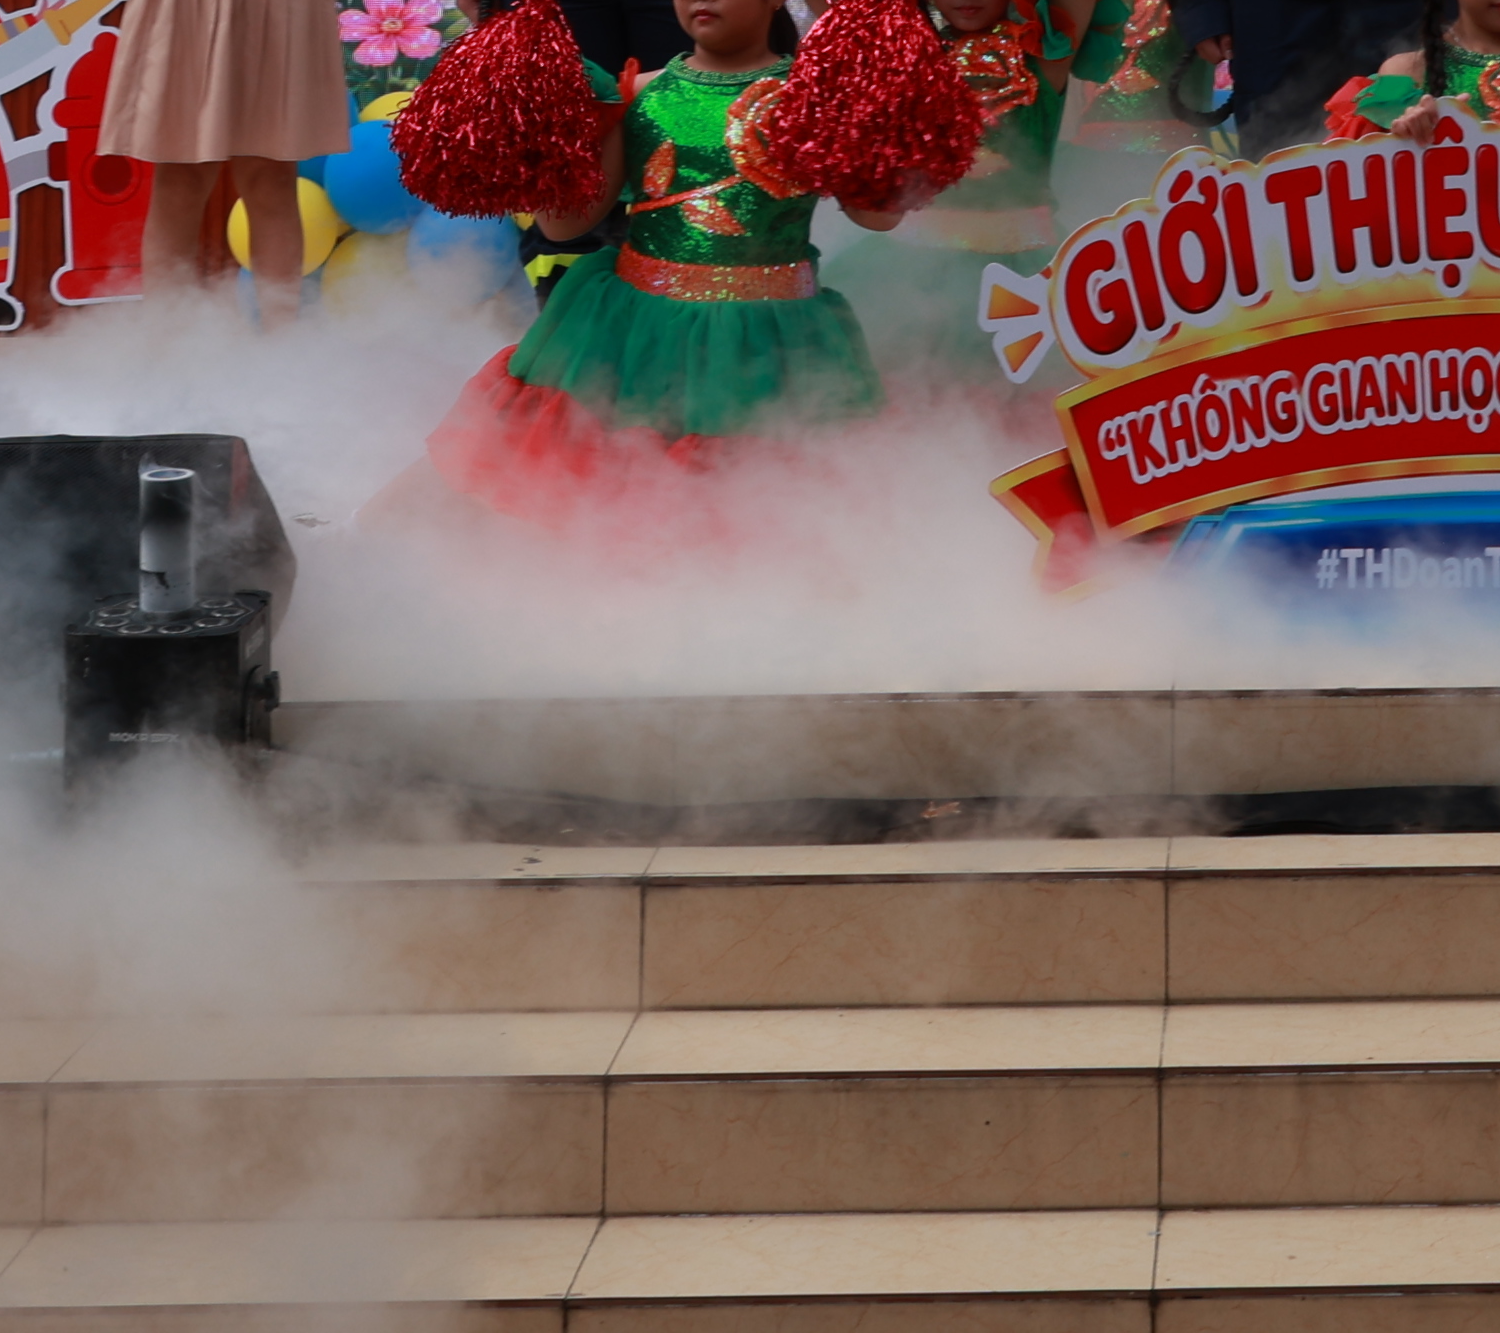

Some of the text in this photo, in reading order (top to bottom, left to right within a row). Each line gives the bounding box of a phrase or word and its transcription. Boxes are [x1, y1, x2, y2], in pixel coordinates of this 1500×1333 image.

[1064, 169, 1259, 355] GIỚI
[1102, 374, 1300, 483] “KHÔNG
[1308, 352, 1418, 433] GIAN
